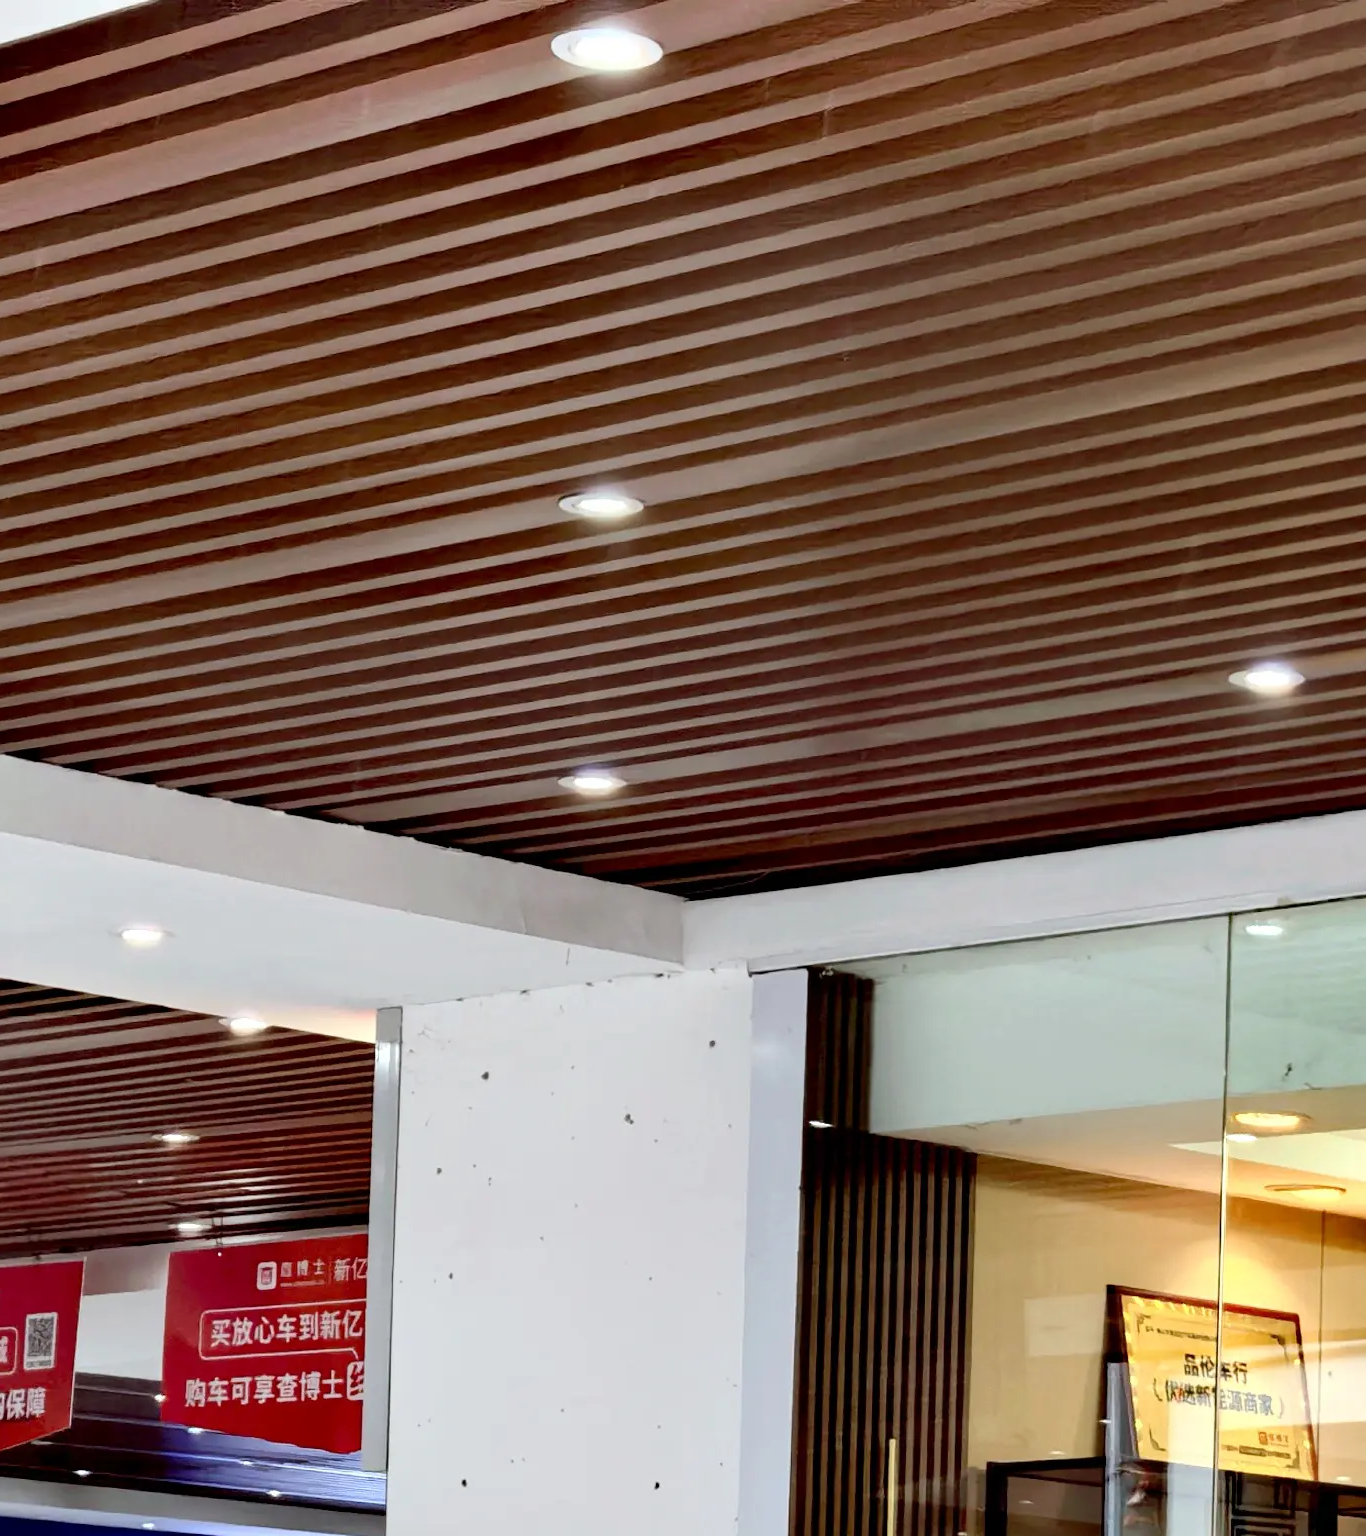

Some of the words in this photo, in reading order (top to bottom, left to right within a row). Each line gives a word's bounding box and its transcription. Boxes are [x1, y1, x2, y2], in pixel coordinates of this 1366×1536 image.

[333, 1256, 368, 1281] 新亿
[210, 1309, 363, 1348] 买放心车到新亿
